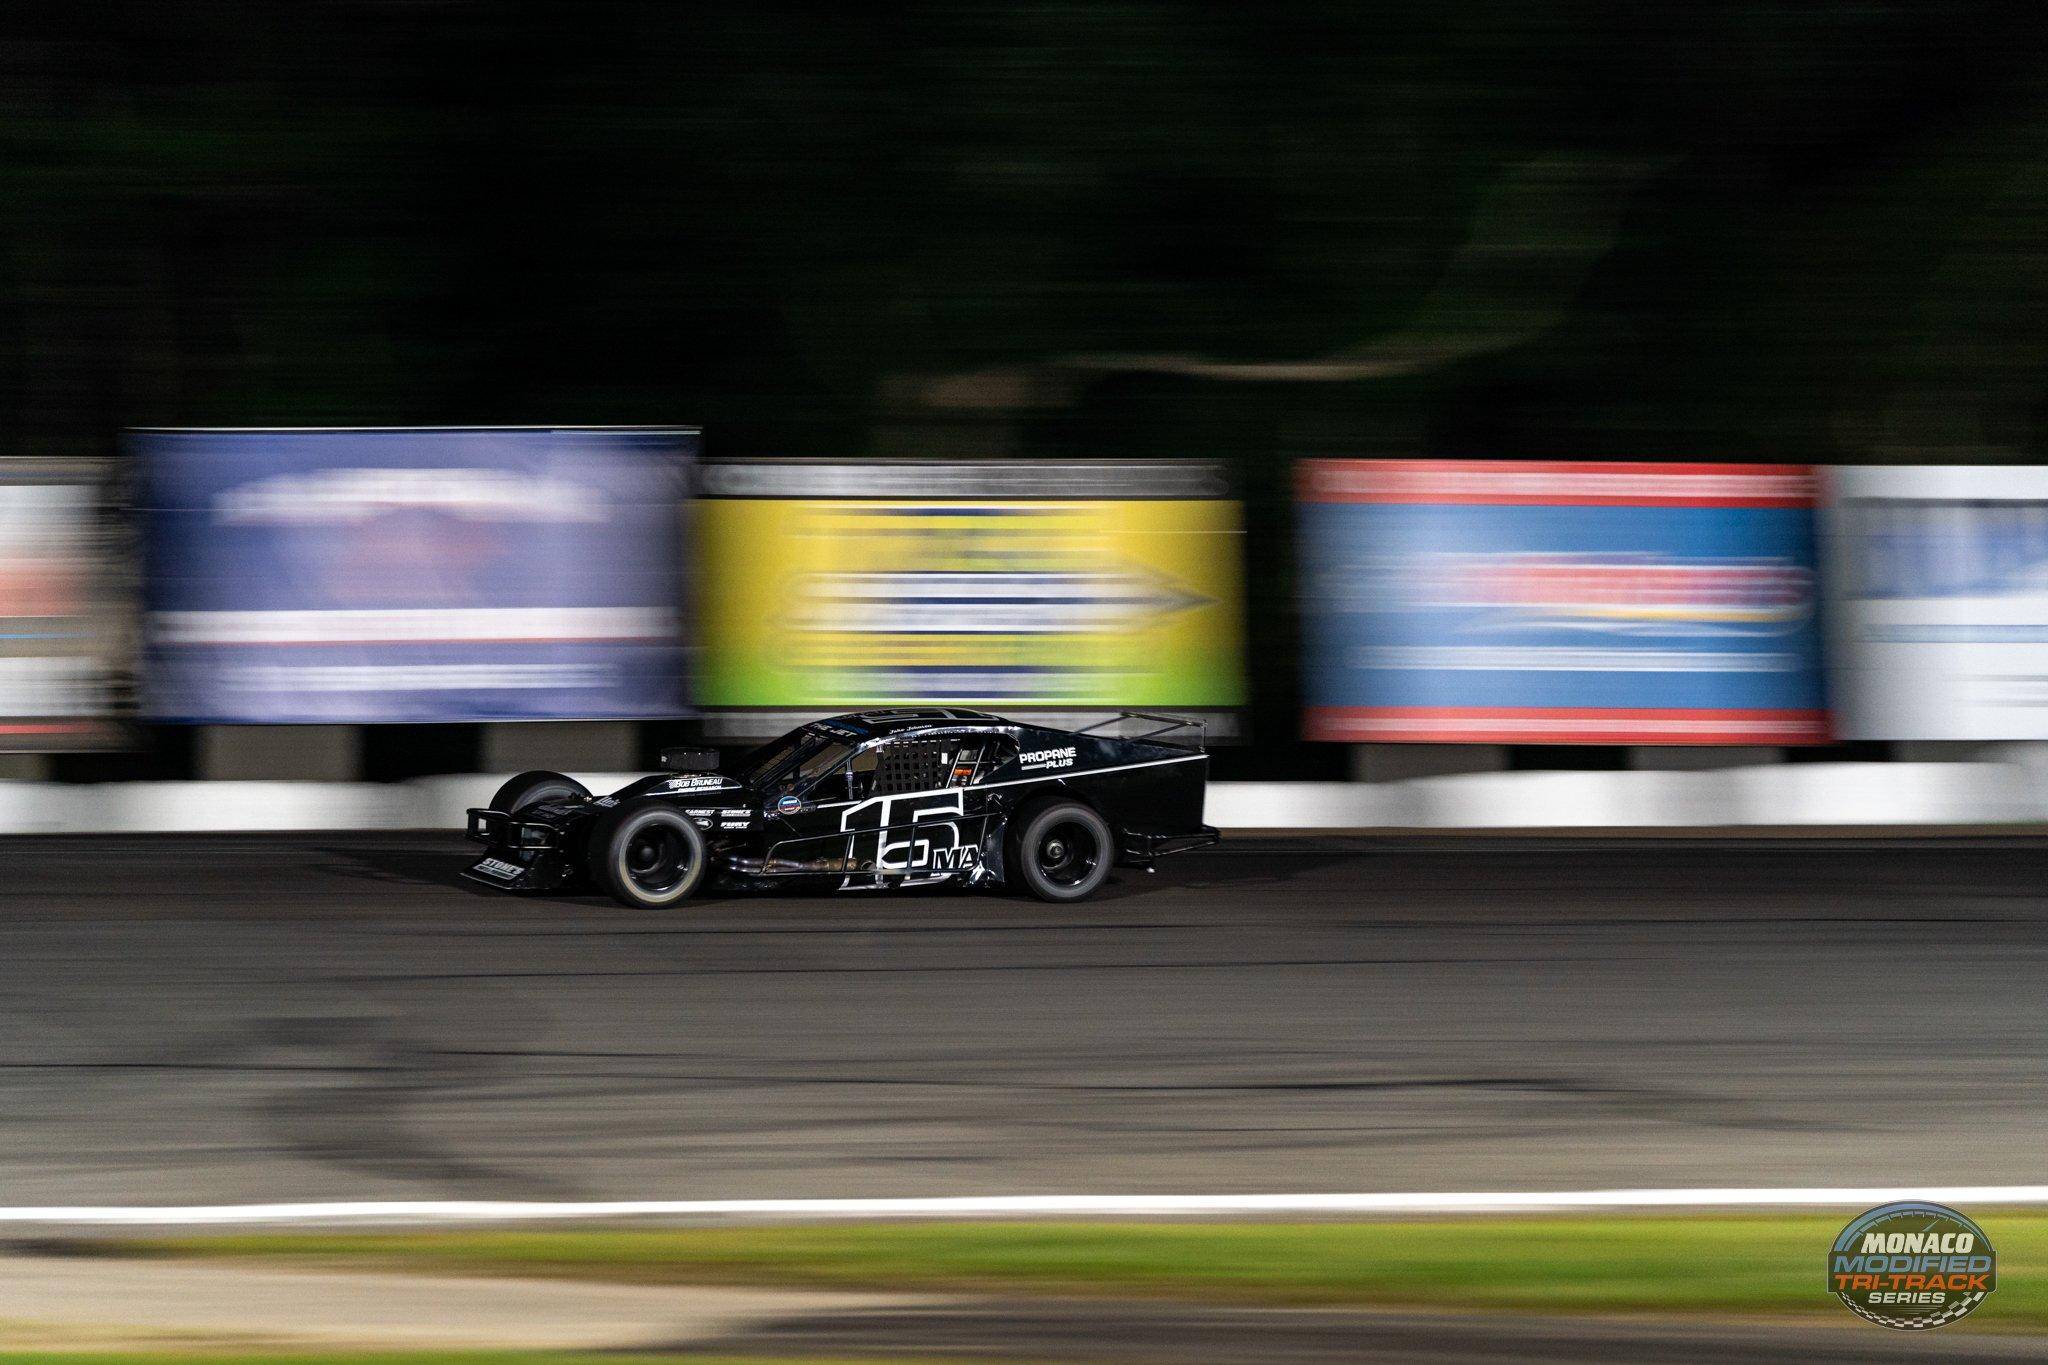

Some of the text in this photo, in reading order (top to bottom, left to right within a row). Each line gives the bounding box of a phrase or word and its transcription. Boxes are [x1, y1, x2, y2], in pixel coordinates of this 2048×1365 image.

[1018, 746, 1078, 764] PROPANE
[1045, 758, 1074, 770] PLUS
[691, 778, 723, 787] BRUNEAU
[838, 788, 964, 890] 15
[482, 857, 525, 875] STONE'S
[932, 845, 990, 871] MA
